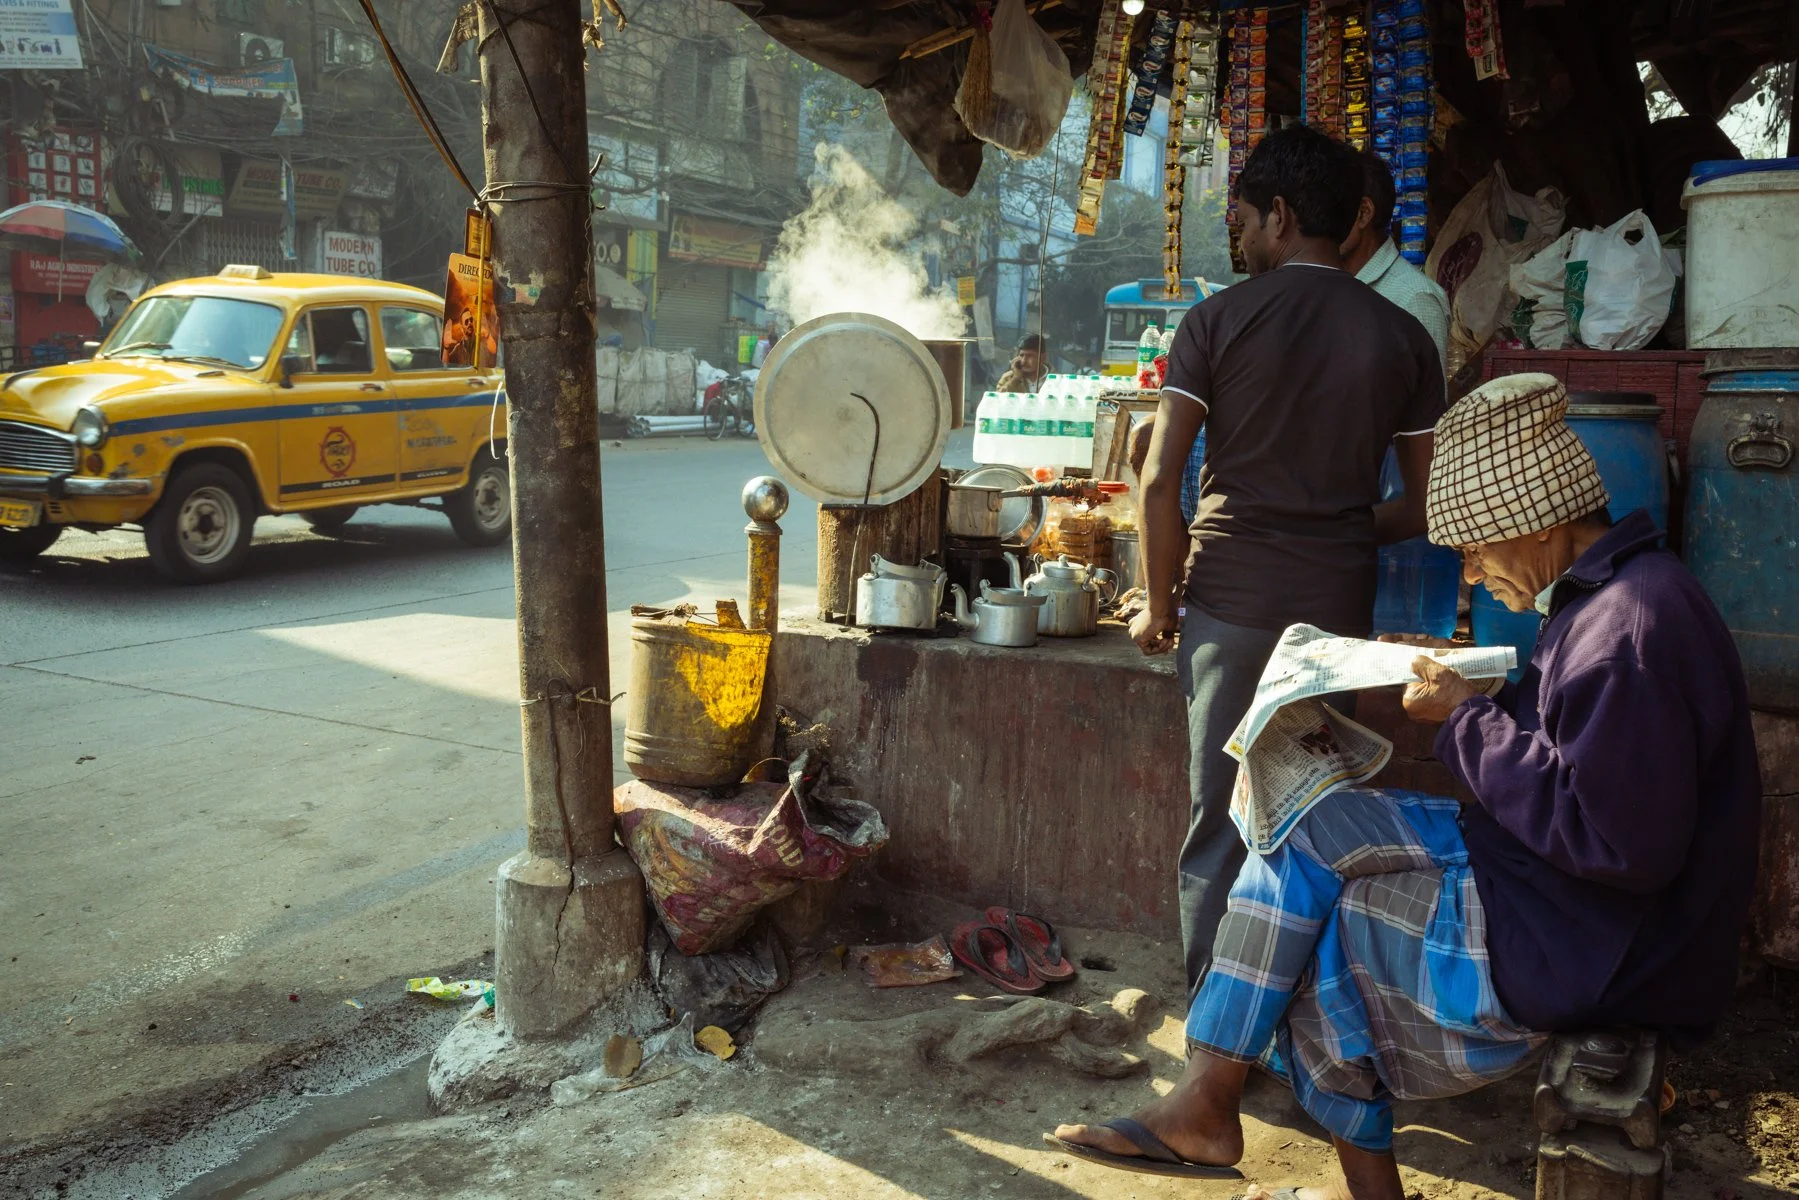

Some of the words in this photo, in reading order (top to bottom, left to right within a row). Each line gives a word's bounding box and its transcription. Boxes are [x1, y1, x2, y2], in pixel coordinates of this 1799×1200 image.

[27, 0, 59, 8] FITTINGS
[296, 172, 324, 188] TUBE
[329, 236, 374, 256] MODERN
[30, 259, 46, 270] RAJ
[326, 256, 355, 274] TUBE
[358, 259, 376, 276] CO
[322, 479, 360, 489] ROAD
[768, 824, 804, 867] OLD
